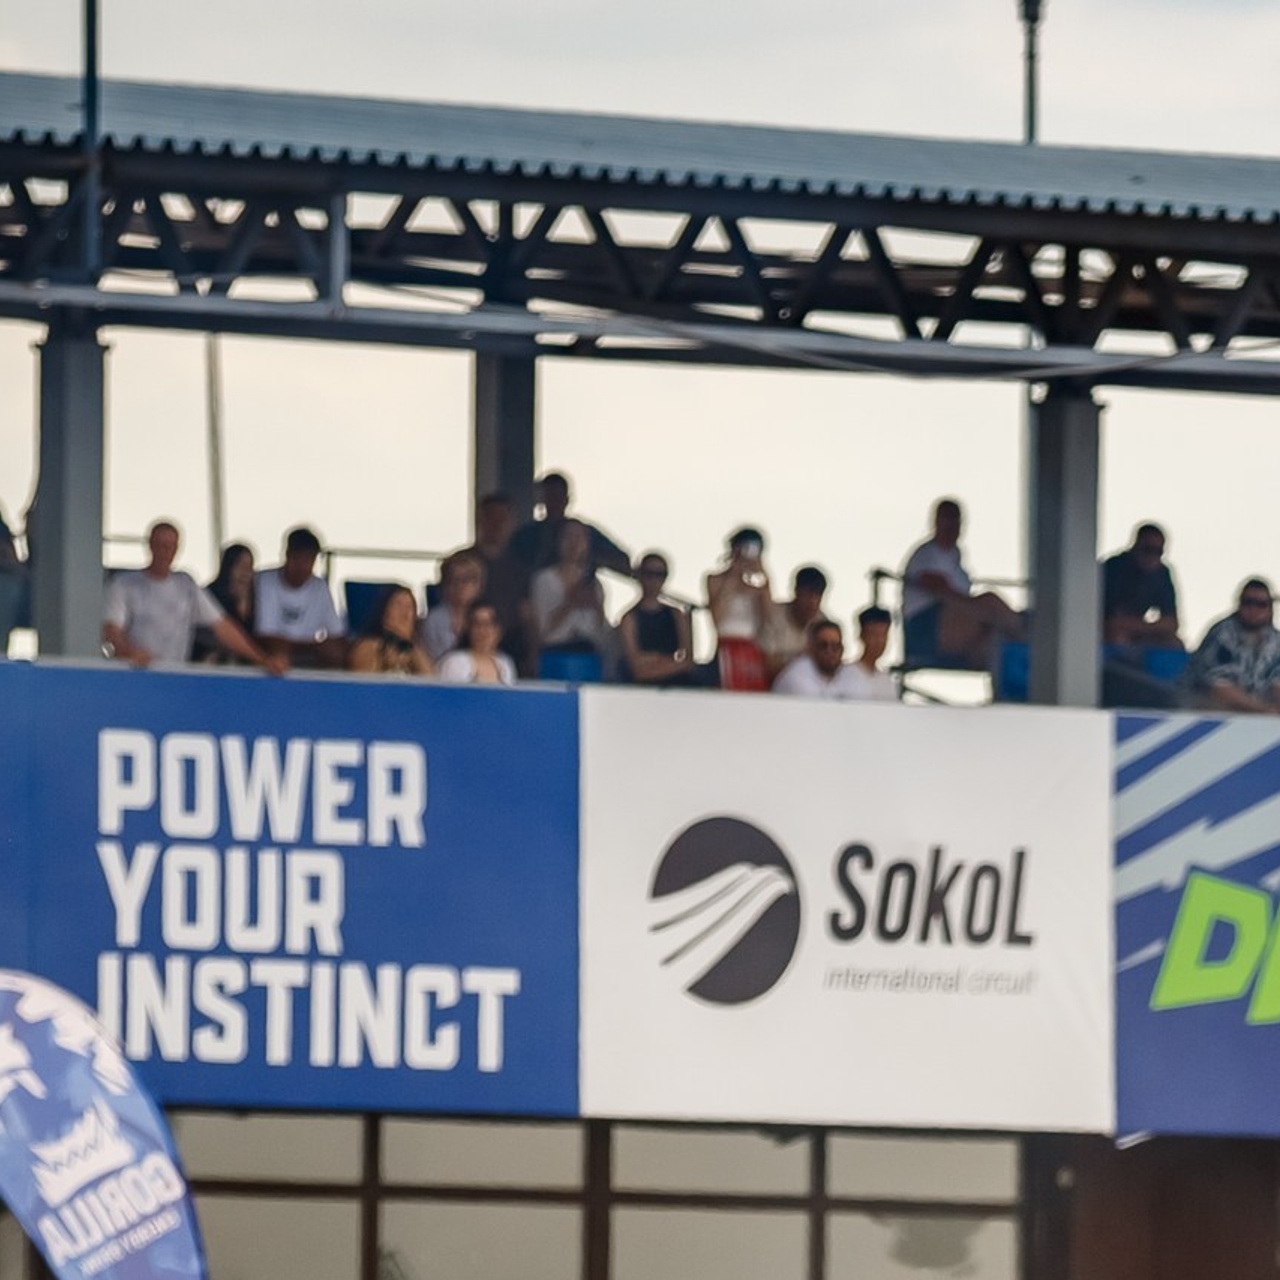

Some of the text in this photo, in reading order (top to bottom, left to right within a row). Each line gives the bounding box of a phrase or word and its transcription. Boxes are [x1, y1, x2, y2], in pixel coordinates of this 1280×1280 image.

[98, 727, 428, 848] POWER
[96, 841, 345, 955] YOUR
[100, 952, 520, 1073] INSTINCT
